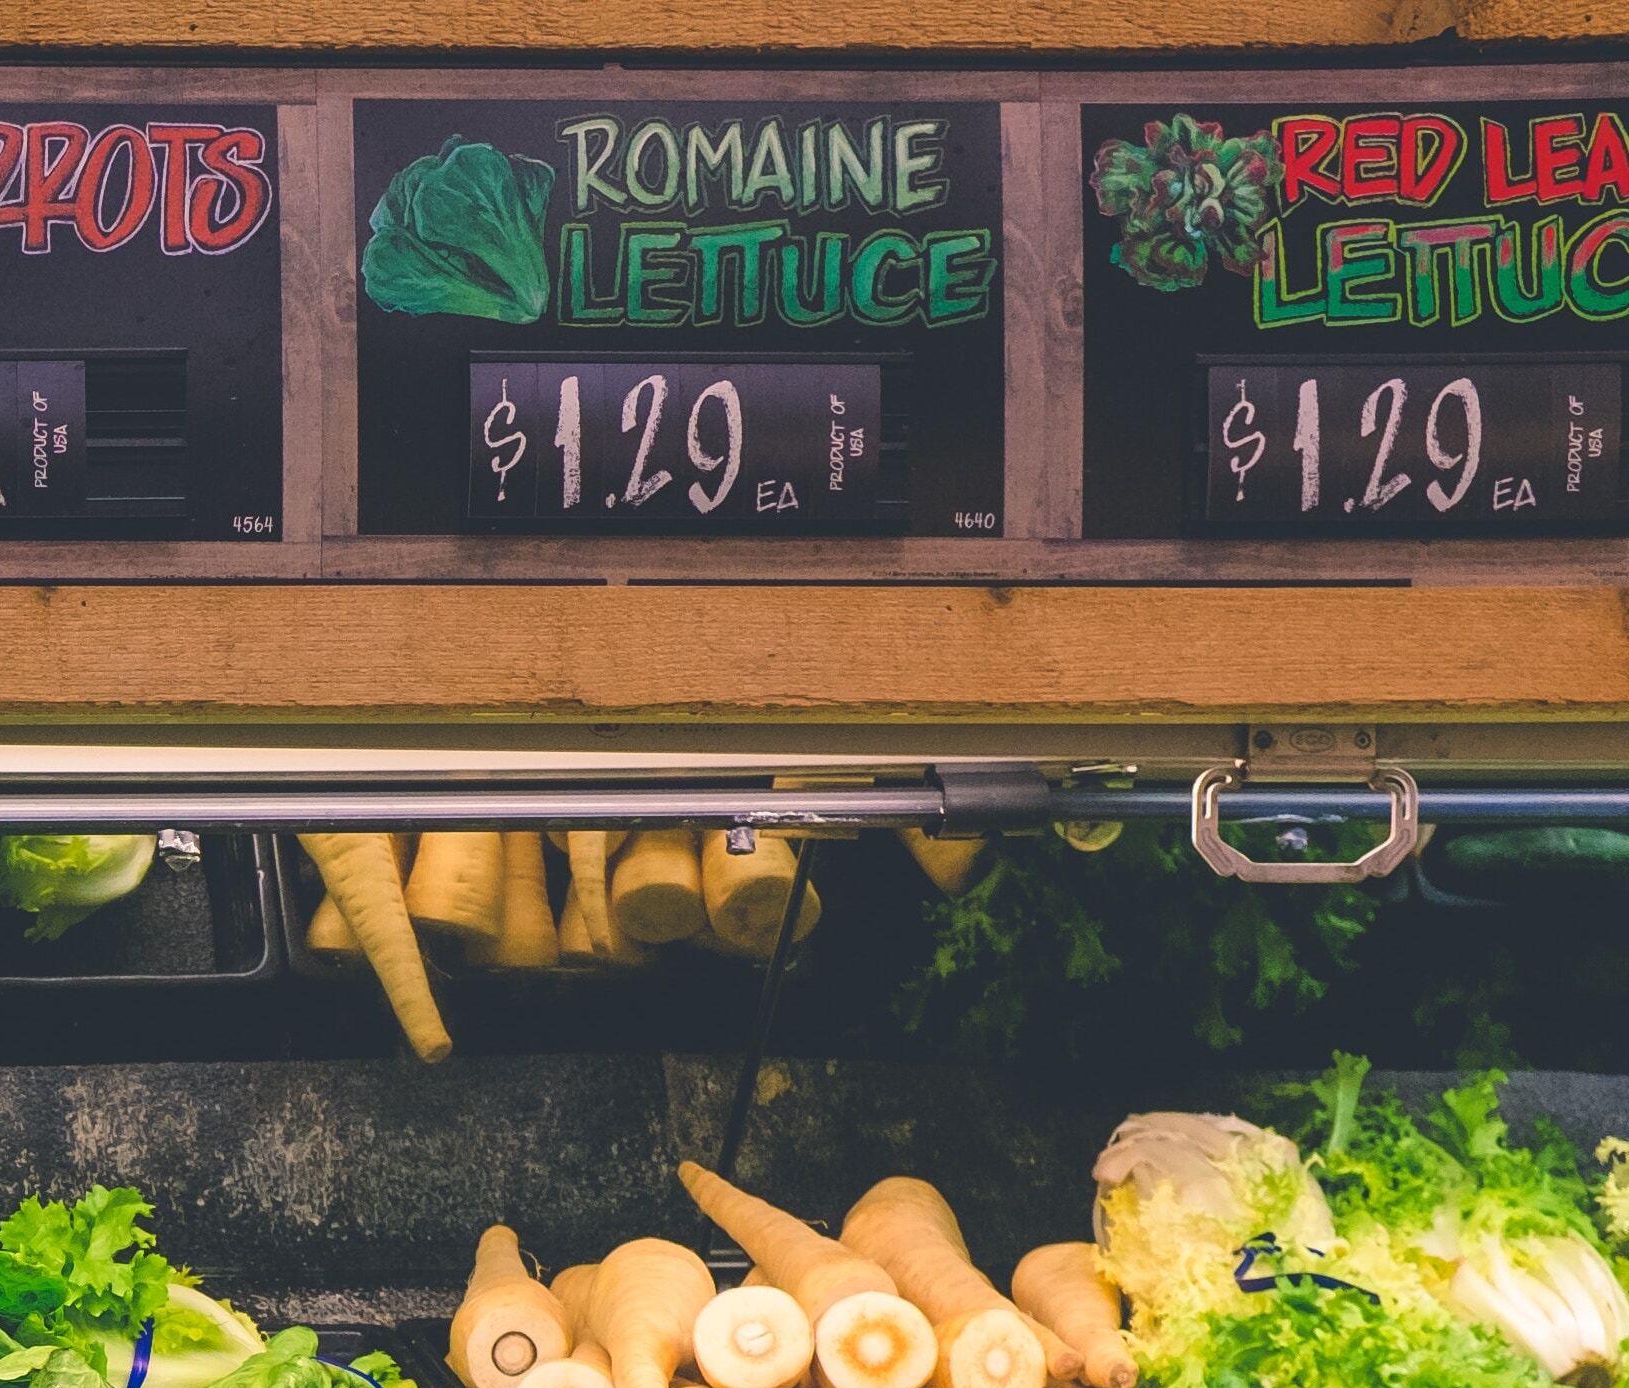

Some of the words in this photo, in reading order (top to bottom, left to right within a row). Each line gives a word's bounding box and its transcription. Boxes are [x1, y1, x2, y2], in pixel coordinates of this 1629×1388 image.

[557, 113, 948, 218] ROMAINE
[1271, 111, 1466, 206] RED
[556, 220, 997, 329] LETTUCE
[32, 391, 49, 413] OF
[829, 393, 846, 416] OF
[1569, 394, 1586, 416] OF
[34, 418, 48, 490] PRODUCT
[53, 423, 68, 455] USA
[829, 419, 846, 491] PRODUCT
[849, 428, 865, 457] USA
[1589, 427, 1604, 458] USA
[1566, 420, 1585, 493] PRODUCT
[755, 480, 800, 514] EA
[1493, 477, 1536, 511] EA
[232, 515, 274, 535] 4564
[954, 511, 996, 531] 4640
